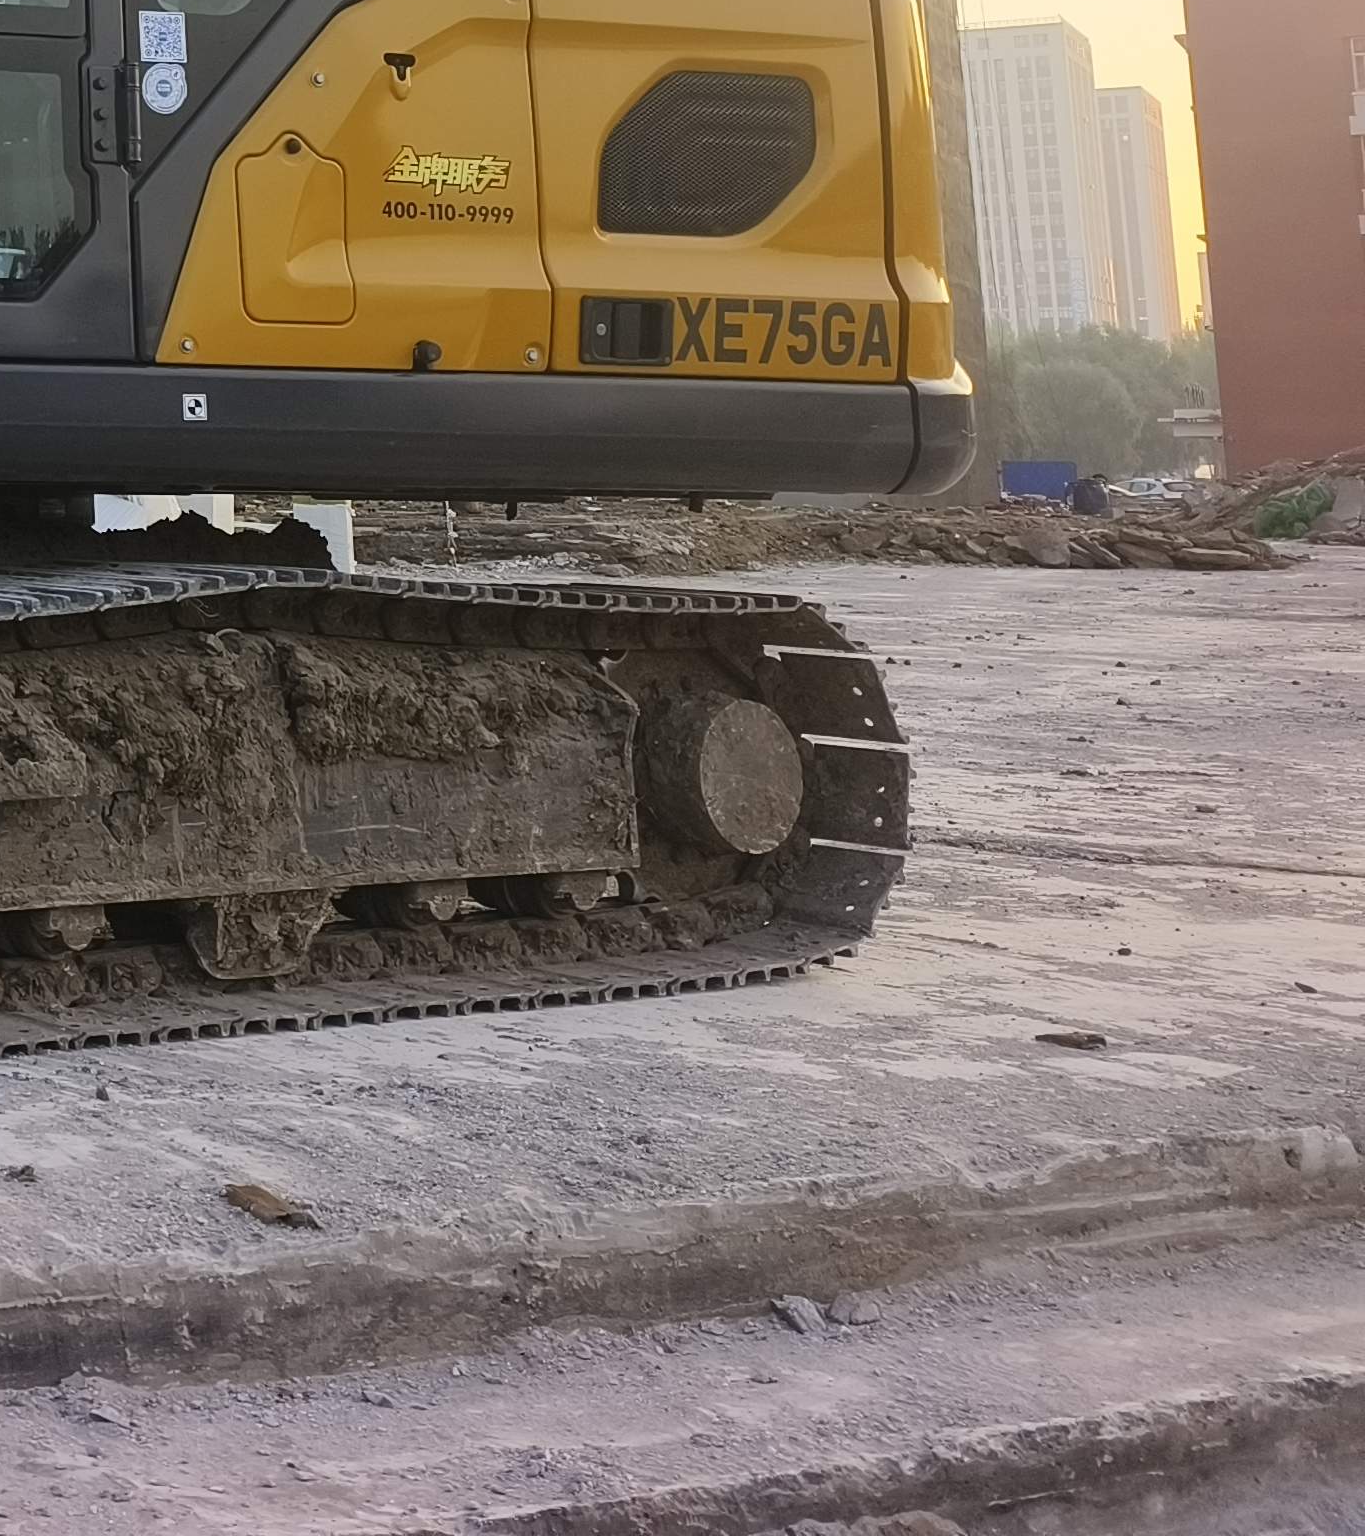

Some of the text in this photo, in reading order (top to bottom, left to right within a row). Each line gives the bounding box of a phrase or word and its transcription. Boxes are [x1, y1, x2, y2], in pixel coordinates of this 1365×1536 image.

[382, 145, 511, 197] 金牌服务
[382, 201, 514, 224] 400-110-9999
[674, 297, 892, 368] XE75GA
